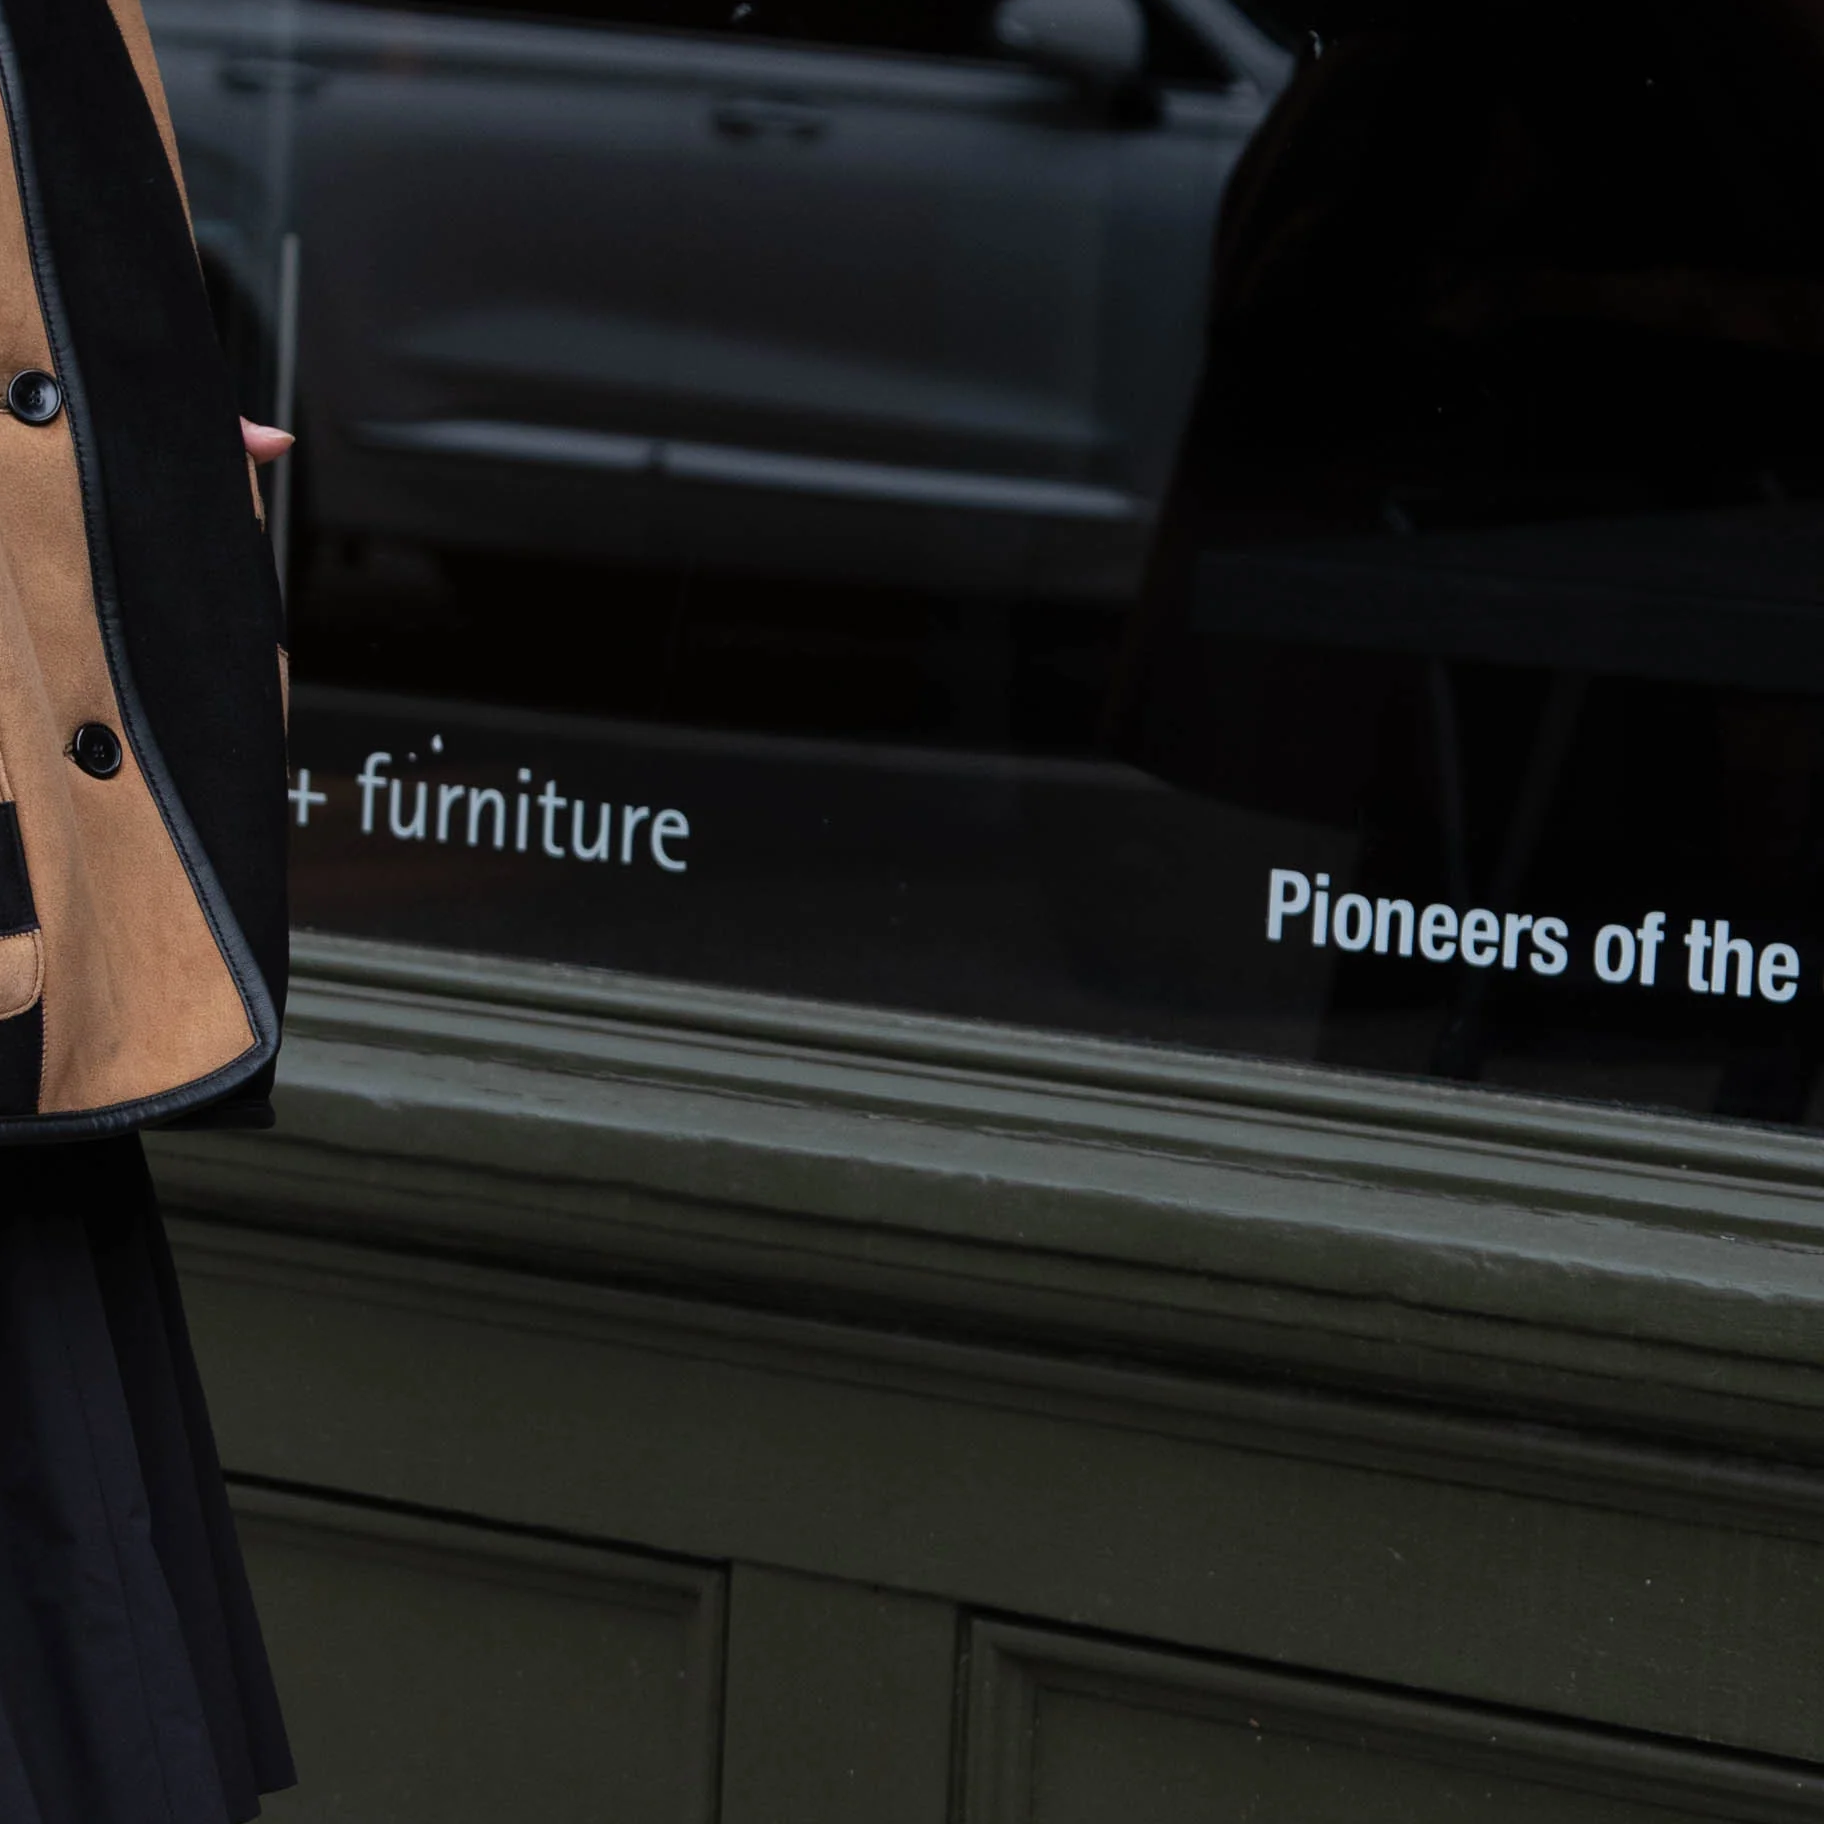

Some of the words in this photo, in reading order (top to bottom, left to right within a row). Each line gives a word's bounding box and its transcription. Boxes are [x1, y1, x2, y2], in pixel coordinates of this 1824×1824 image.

[356, 752, 690, 871] furniture
[1267, 868, 1569, 976] Pioneers
[1593, 911, 1666, 986] of
[1684, 919, 1800, 1002] the
